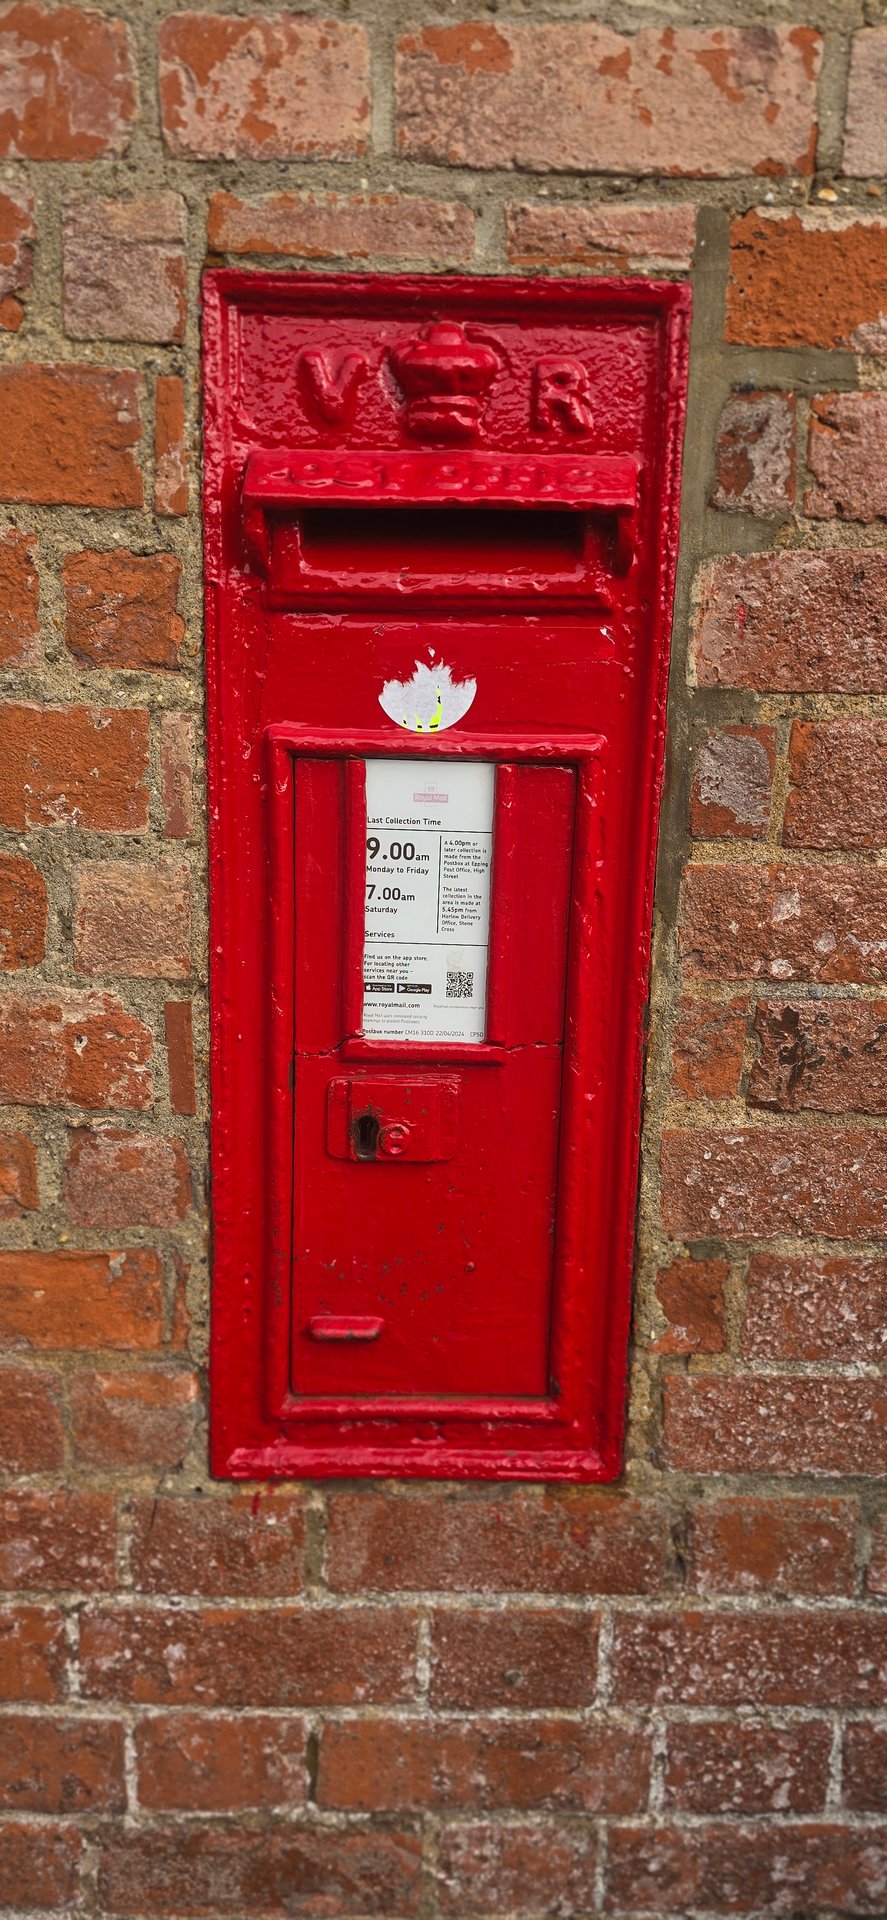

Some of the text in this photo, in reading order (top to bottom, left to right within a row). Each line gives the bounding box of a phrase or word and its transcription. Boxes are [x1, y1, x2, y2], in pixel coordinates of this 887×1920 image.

[301, 348, 594, 432] V R
[367, 816, 441, 826] Last Collection Time
[366, 837, 429, 861] 9.00am
[366, 865, 394, 874] Monday
[406, 867, 429, 875] Friday
[366, 884, 415, 901] 7.00am
[365, 905, 398, 914] Saturday
[364, 930, 395, 938] Services
